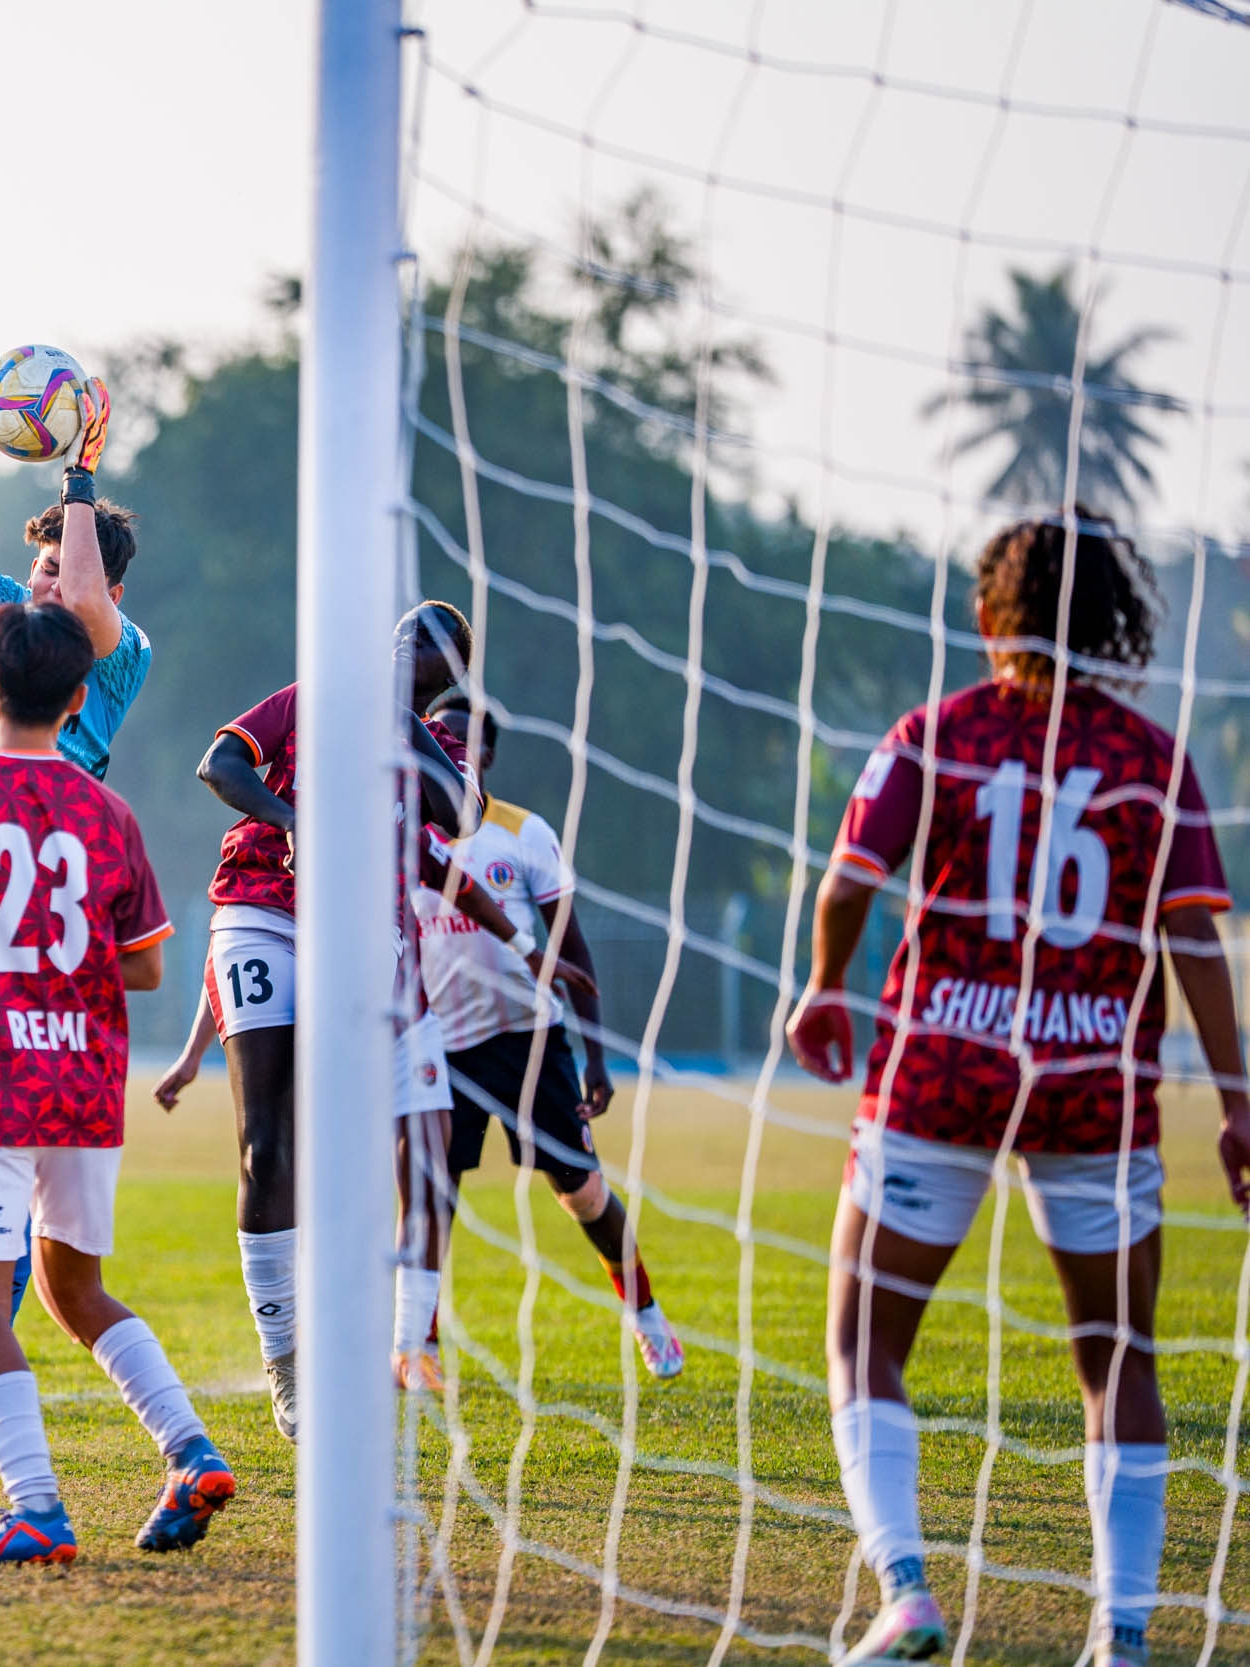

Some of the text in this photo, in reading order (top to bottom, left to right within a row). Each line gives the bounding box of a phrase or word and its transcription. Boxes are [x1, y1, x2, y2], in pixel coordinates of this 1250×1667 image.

[976, 759, 1110, 949] 16
[227, 959, 273, 1008] 13
[6, 1010, 87, 1052] REMI
